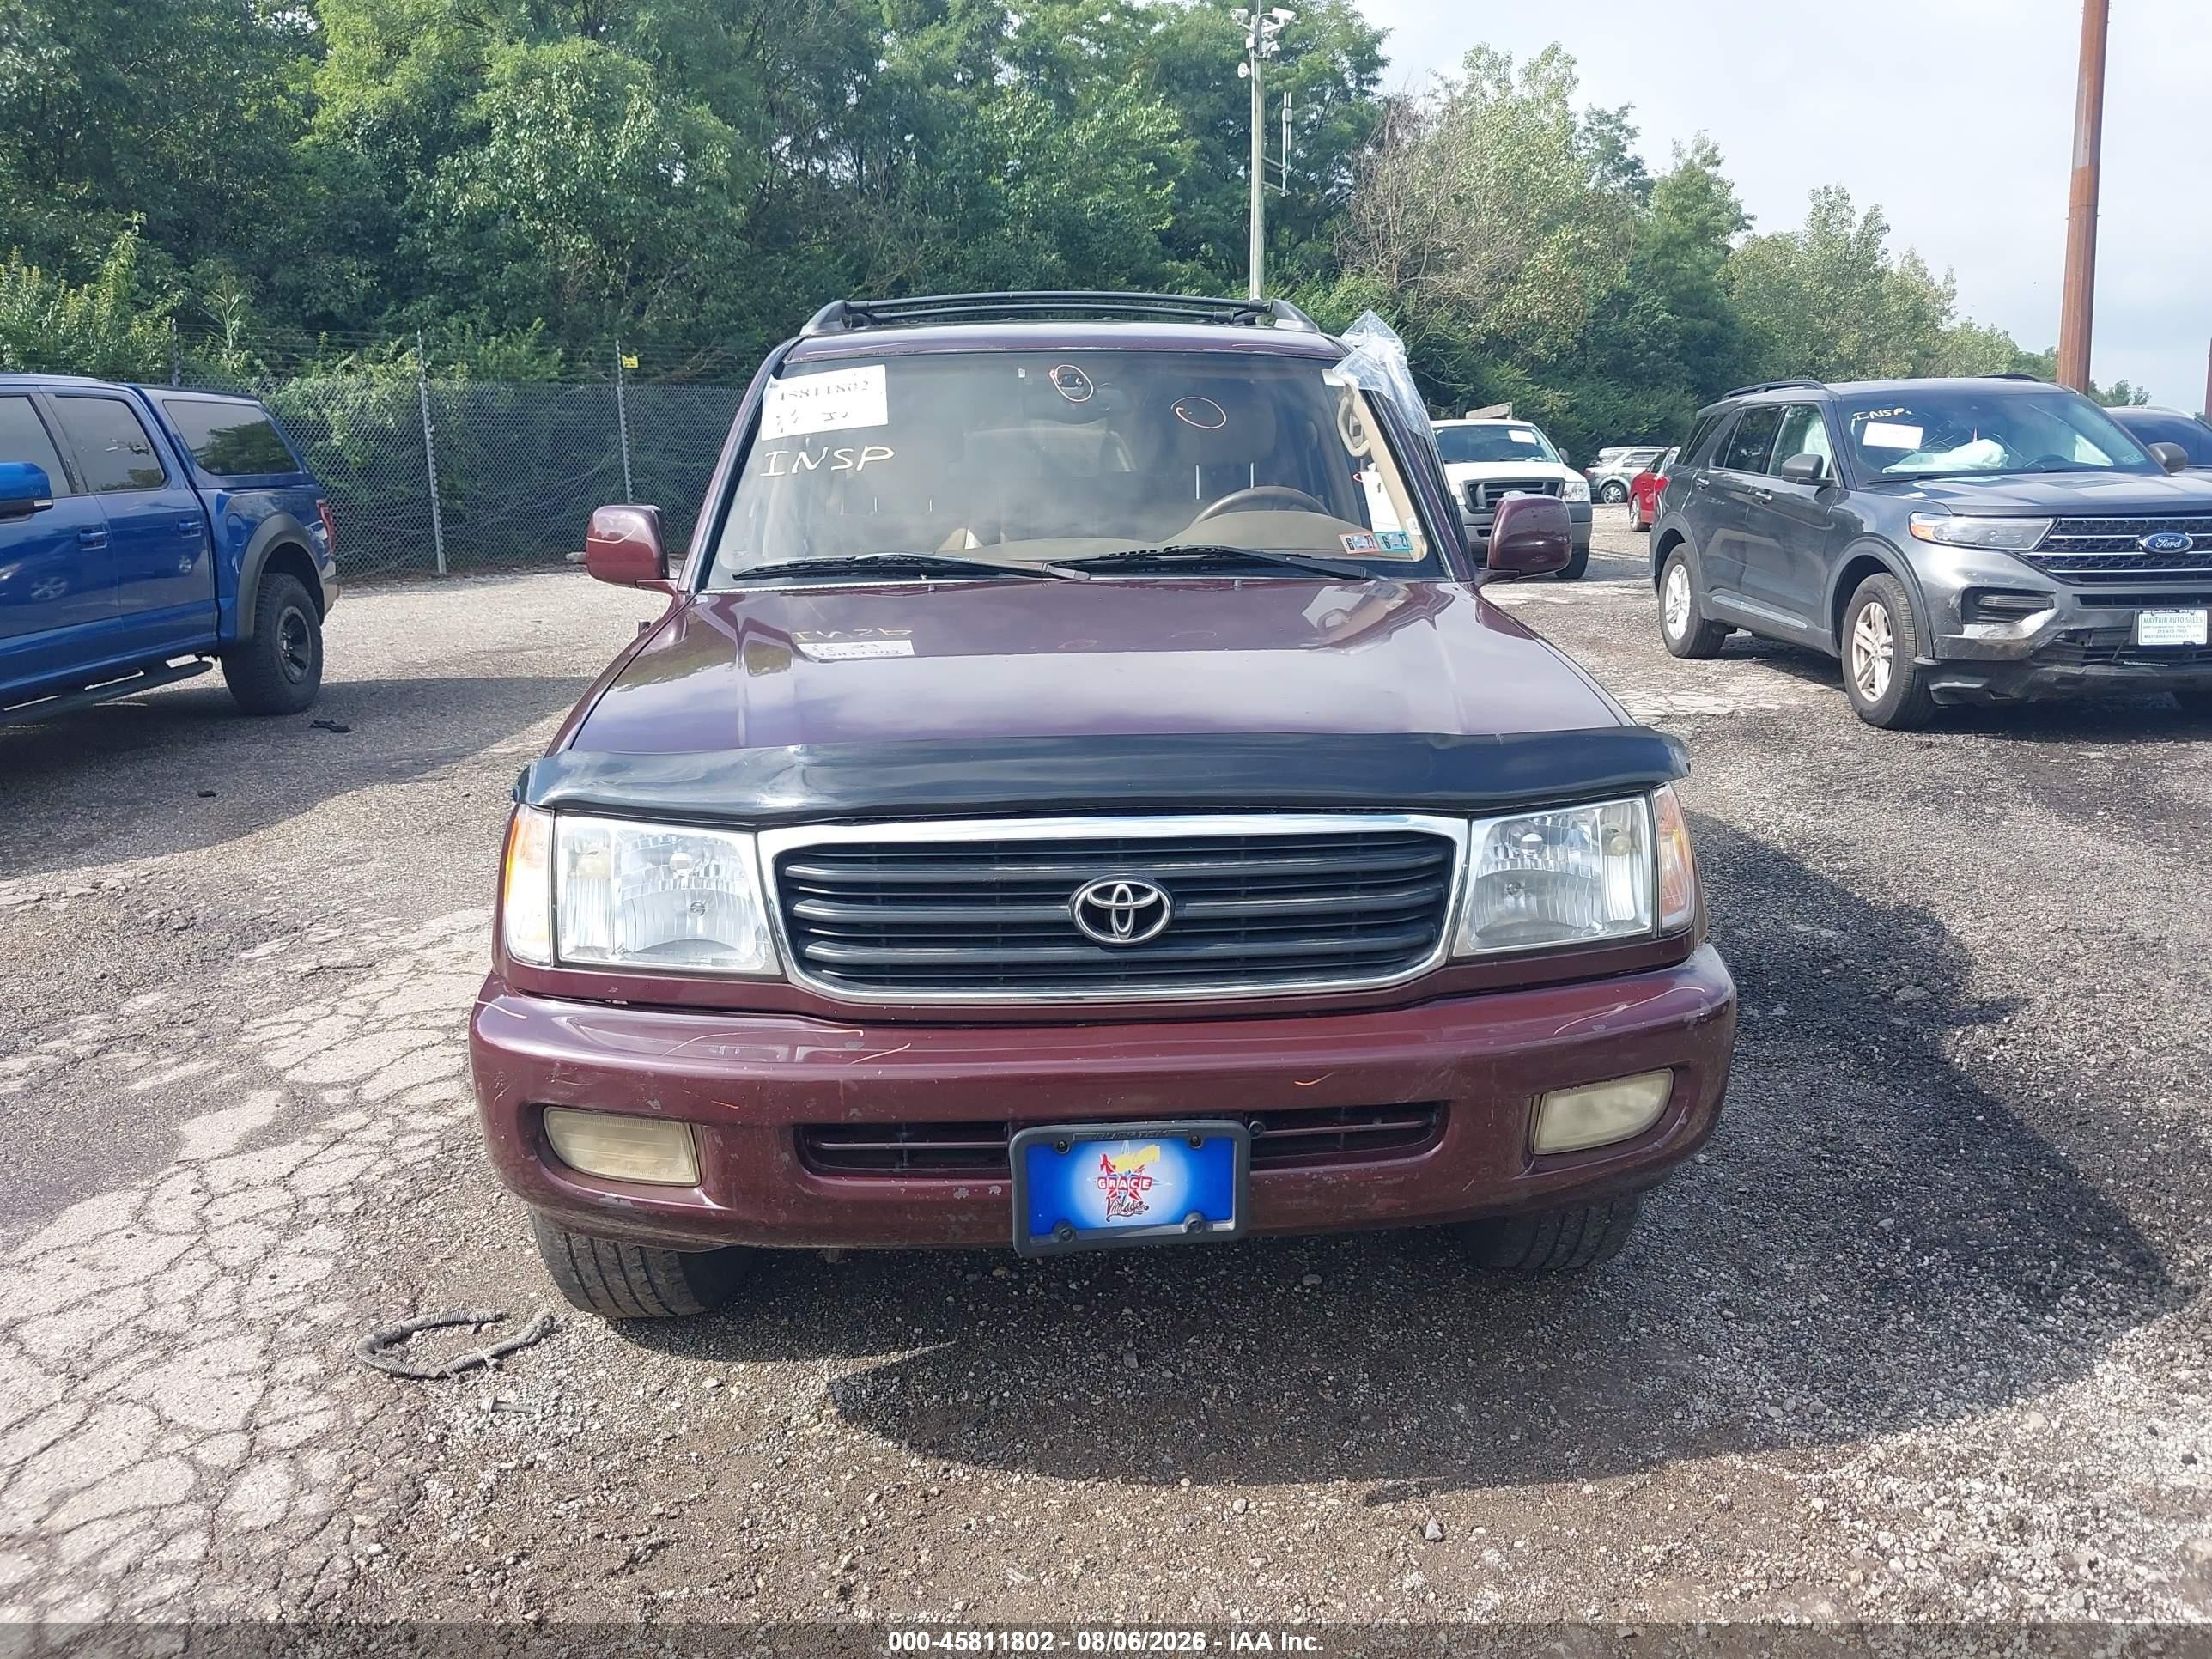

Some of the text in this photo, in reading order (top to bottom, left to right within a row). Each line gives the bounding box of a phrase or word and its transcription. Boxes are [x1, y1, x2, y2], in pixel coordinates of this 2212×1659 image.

[760, 445, 896, 477] INSP
[2155, 537, 2183, 549] Ford
[1097, 1176, 1152, 1191] GRACE
